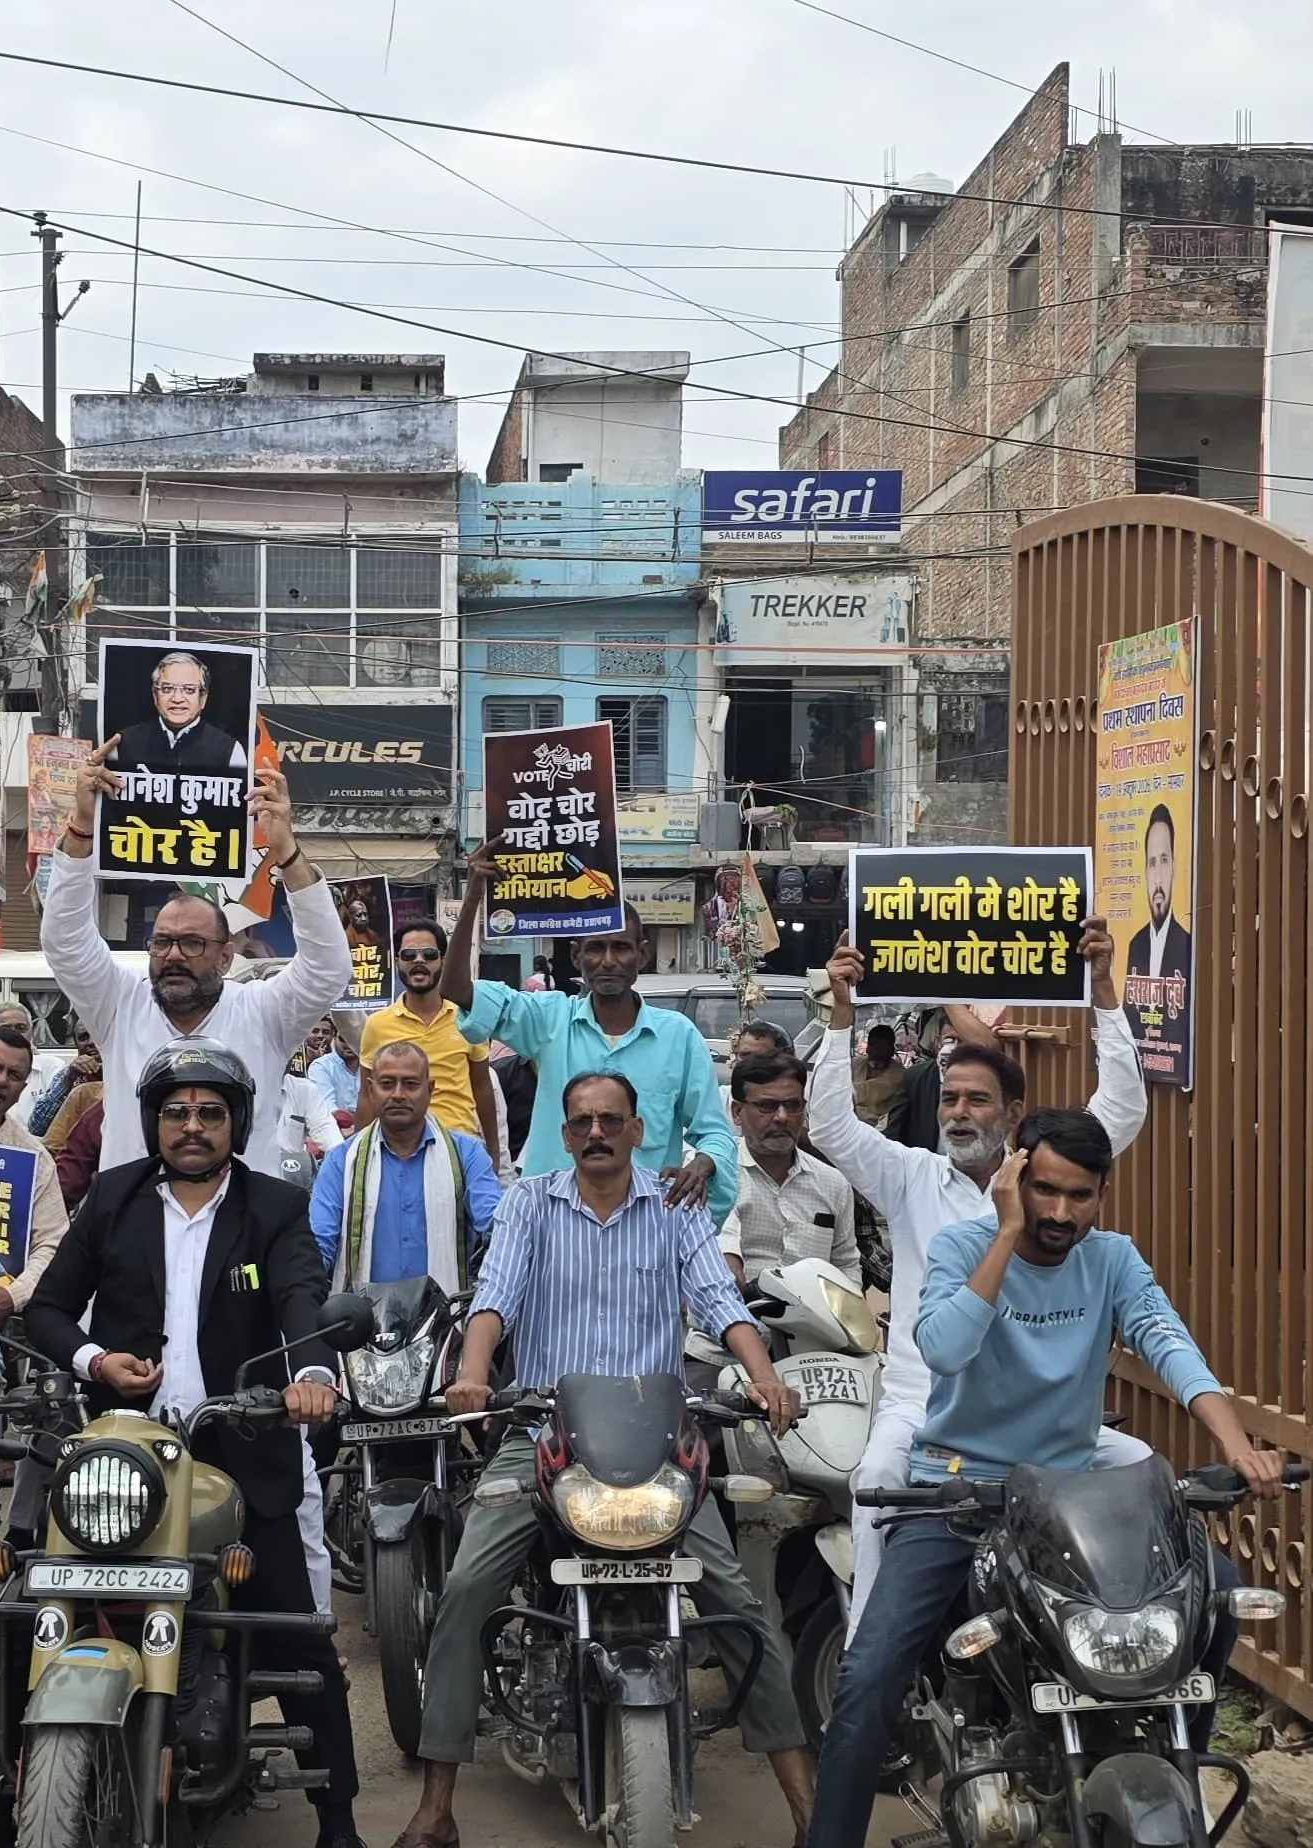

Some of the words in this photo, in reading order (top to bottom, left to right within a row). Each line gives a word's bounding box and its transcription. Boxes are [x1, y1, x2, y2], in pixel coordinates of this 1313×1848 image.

[731, 477, 877, 522] safari
[718, 531, 755, 540] SALEEM
[758, 531, 782, 540] BAGS
[750, 594, 868, 618] TREKKER
[1102, 704, 1123, 735] प्रथम
[1125, 700, 1157, 729] स्थापना
[1159, 692, 1185, 720] दिवस
[277, 740, 424, 764] RCULES
[566, 751, 592, 773] चोरी
[1111, 741, 1135, 773] विशाल
[512, 770, 550, 784] VOTE
[179, 773, 244, 812] कुमार
[341, 789, 362, 797] CYCLE
[363, 789, 383, 797] STORE
[507, 792, 553, 820] वोट
[556, 787, 597, 817] चोर
[108, 815, 183, 864] चोर
[502, 823, 551, 851] गद्दी
[553, 816, 600, 848] छोड़
[494, 851, 566, 873] हस्ताक्षर
[493, 875, 568, 900] अभियान
[862, 876, 916, 921] गली
[919, 876, 972, 921] गली
[975, 877, 1003, 921] मे
[1007, 877, 1058, 922] शोर
[1059, 877, 1080, 922] है
[871, 929, 952, 974] ज्ञानेश
[954, 930, 999, 975] वोट
[1000, 930, 1047, 975] चोर
[1049, 930, 1070, 976] है
[375, 1333, 396, 1343] TVS
[799, 1357, 840, 1365] HONDA
[806, 1385, 859, 1401] F2241
[51, 1568, 74, 1586] UP
[82, 1569, 129, 1587] 72CC
[137, 1571, 185, 1589] 2424
